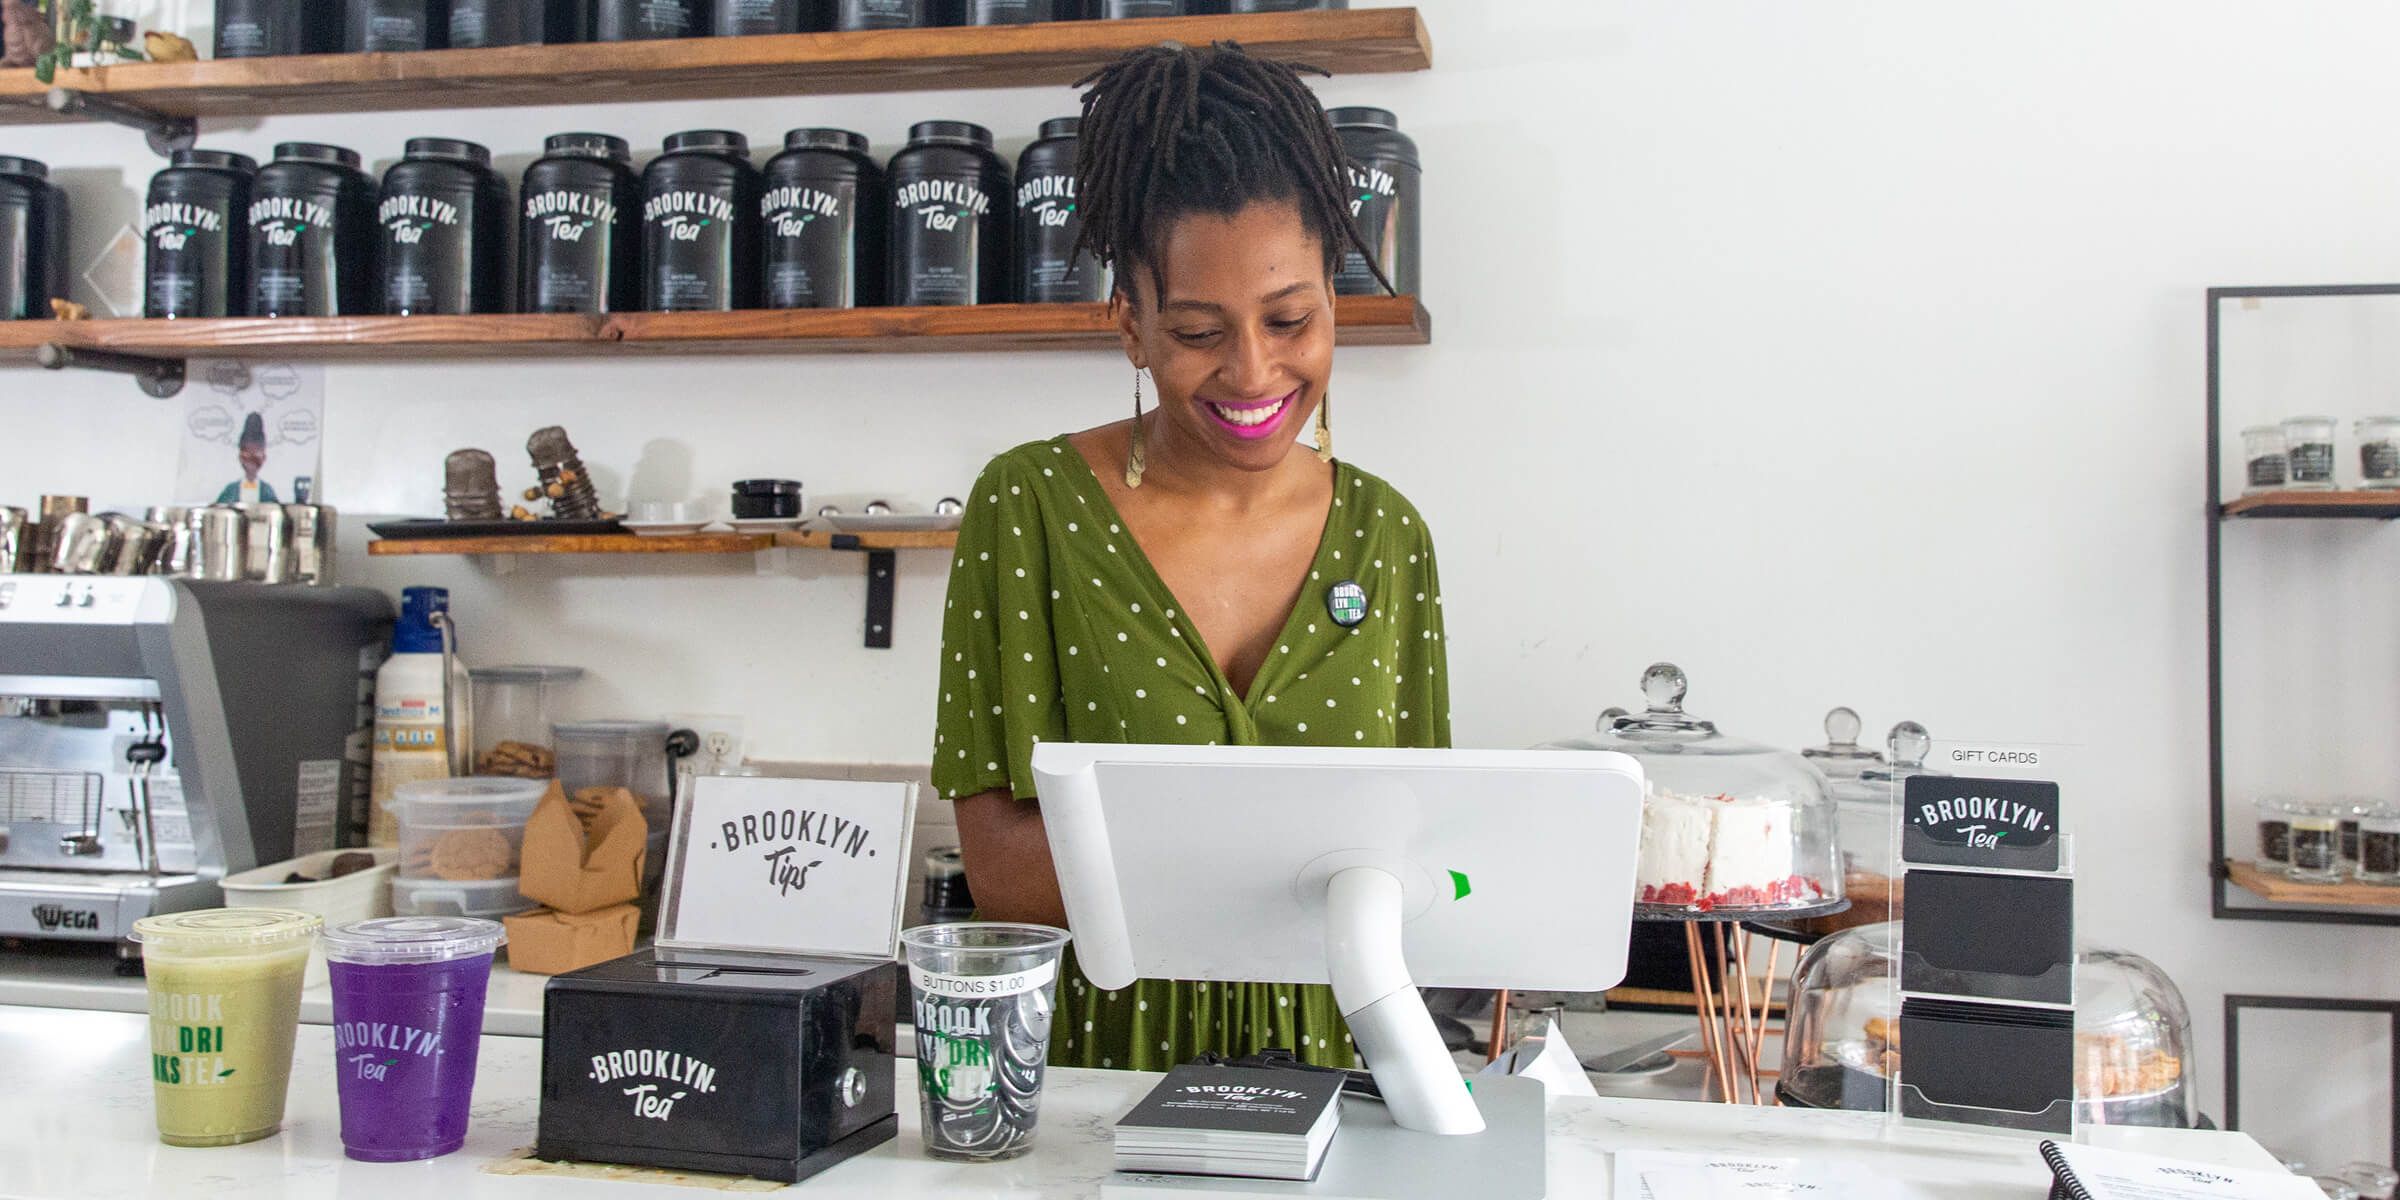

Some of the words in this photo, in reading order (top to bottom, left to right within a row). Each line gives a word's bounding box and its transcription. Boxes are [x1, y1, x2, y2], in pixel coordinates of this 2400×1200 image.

[897, 180, 989, 213] BROOKLYN
[1018, 175, 1075, 208] BROOKL
[526, 191, 615, 223] BROOKLYN
[645, 191, 731, 221] BROOKLYN
[918, 205, 957, 232] Tea
[1032, 200, 1069, 227] Tea
[153, 224, 187, 250] Tea
[261, 220, 298, 246] Tea
[389, 219, 424, 243] Tea
[544, 215, 585, 242] Tea
[661, 215, 701, 241] Tea
[772, 211, 805, 237] Tea
[1952, 750, 1984, 761] GIFT
[1988, 752, 2038, 764] CARDS
[1921, 797, 2043, 831] BROOKLYN
[722, 809, 869, 858] BROOKLYN
[1956, 825, 2000, 849] Tea
[764, 846, 811, 897] Tips
[33, 904, 99, 930] WEGA
[923, 975, 985, 993] BUTTONS
[989, 976, 1025, 992] $1.00
[916, 1000, 991, 1036] BROOK
[336, 1021, 442, 1057] ROOKLYN
[348, 1053, 388, 1081] Tea
[592, 1049, 716, 1094] BROOKLYN
[623, 1084, 675, 1122] Tea
[1184, 1085, 1303, 1098] BROOKLYN
